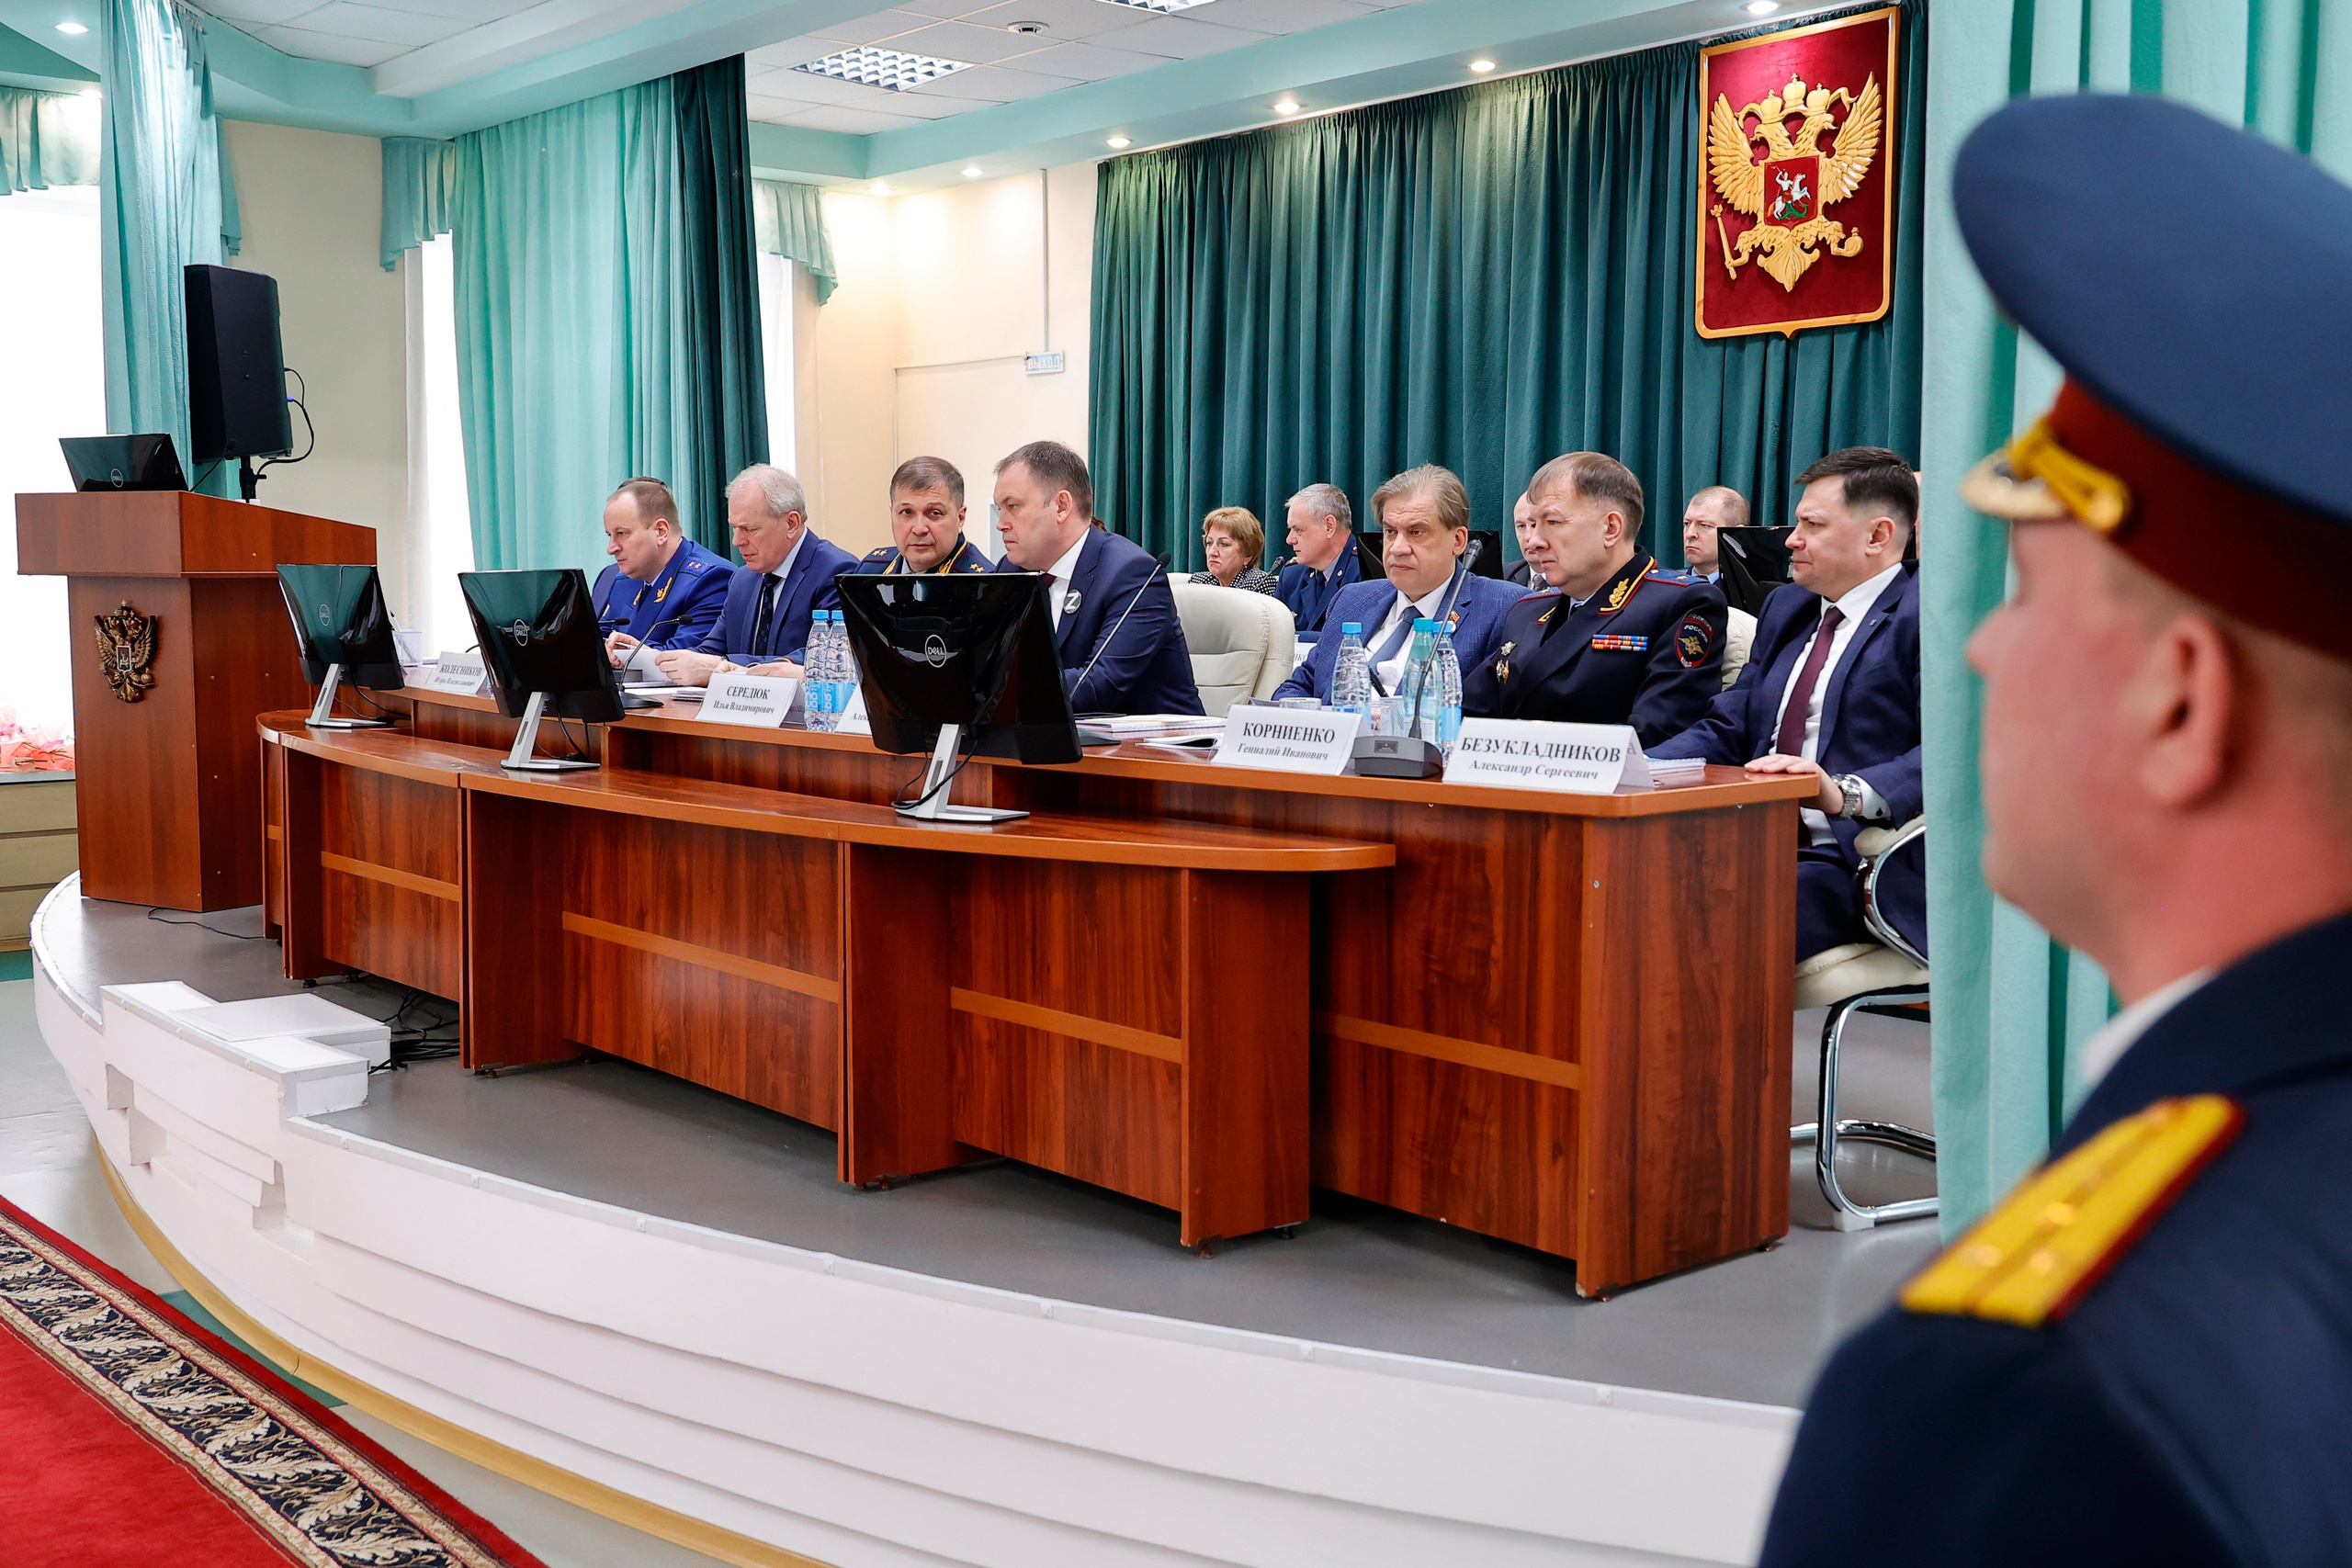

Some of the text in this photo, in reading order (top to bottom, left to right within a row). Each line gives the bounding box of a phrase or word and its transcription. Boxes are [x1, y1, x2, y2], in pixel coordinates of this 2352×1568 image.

[1028, 355, 1060, 370] ВЫХОД
[1065, 592, 1080, 611] Z
[1684, 625, 1709, 643] РОССИЯ
[927, 646, 945, 656] DELL
[439, 664, 483, 677] КОЛЕСНИКОВ
[726, 685, 771, 700] СЕРЕДЮК
[713, 701, 775, 715] Илья Владимирович
[1242, 722, 1336, 744] КОРНИЕНКО
[1238, 742, 1329, 761] Геннадий Иванович
[1461, 737, 1622, 763] БЕЗУКЛАДНИКОВ
[1469, 759, 1599, 780] Александр Сергеевич
